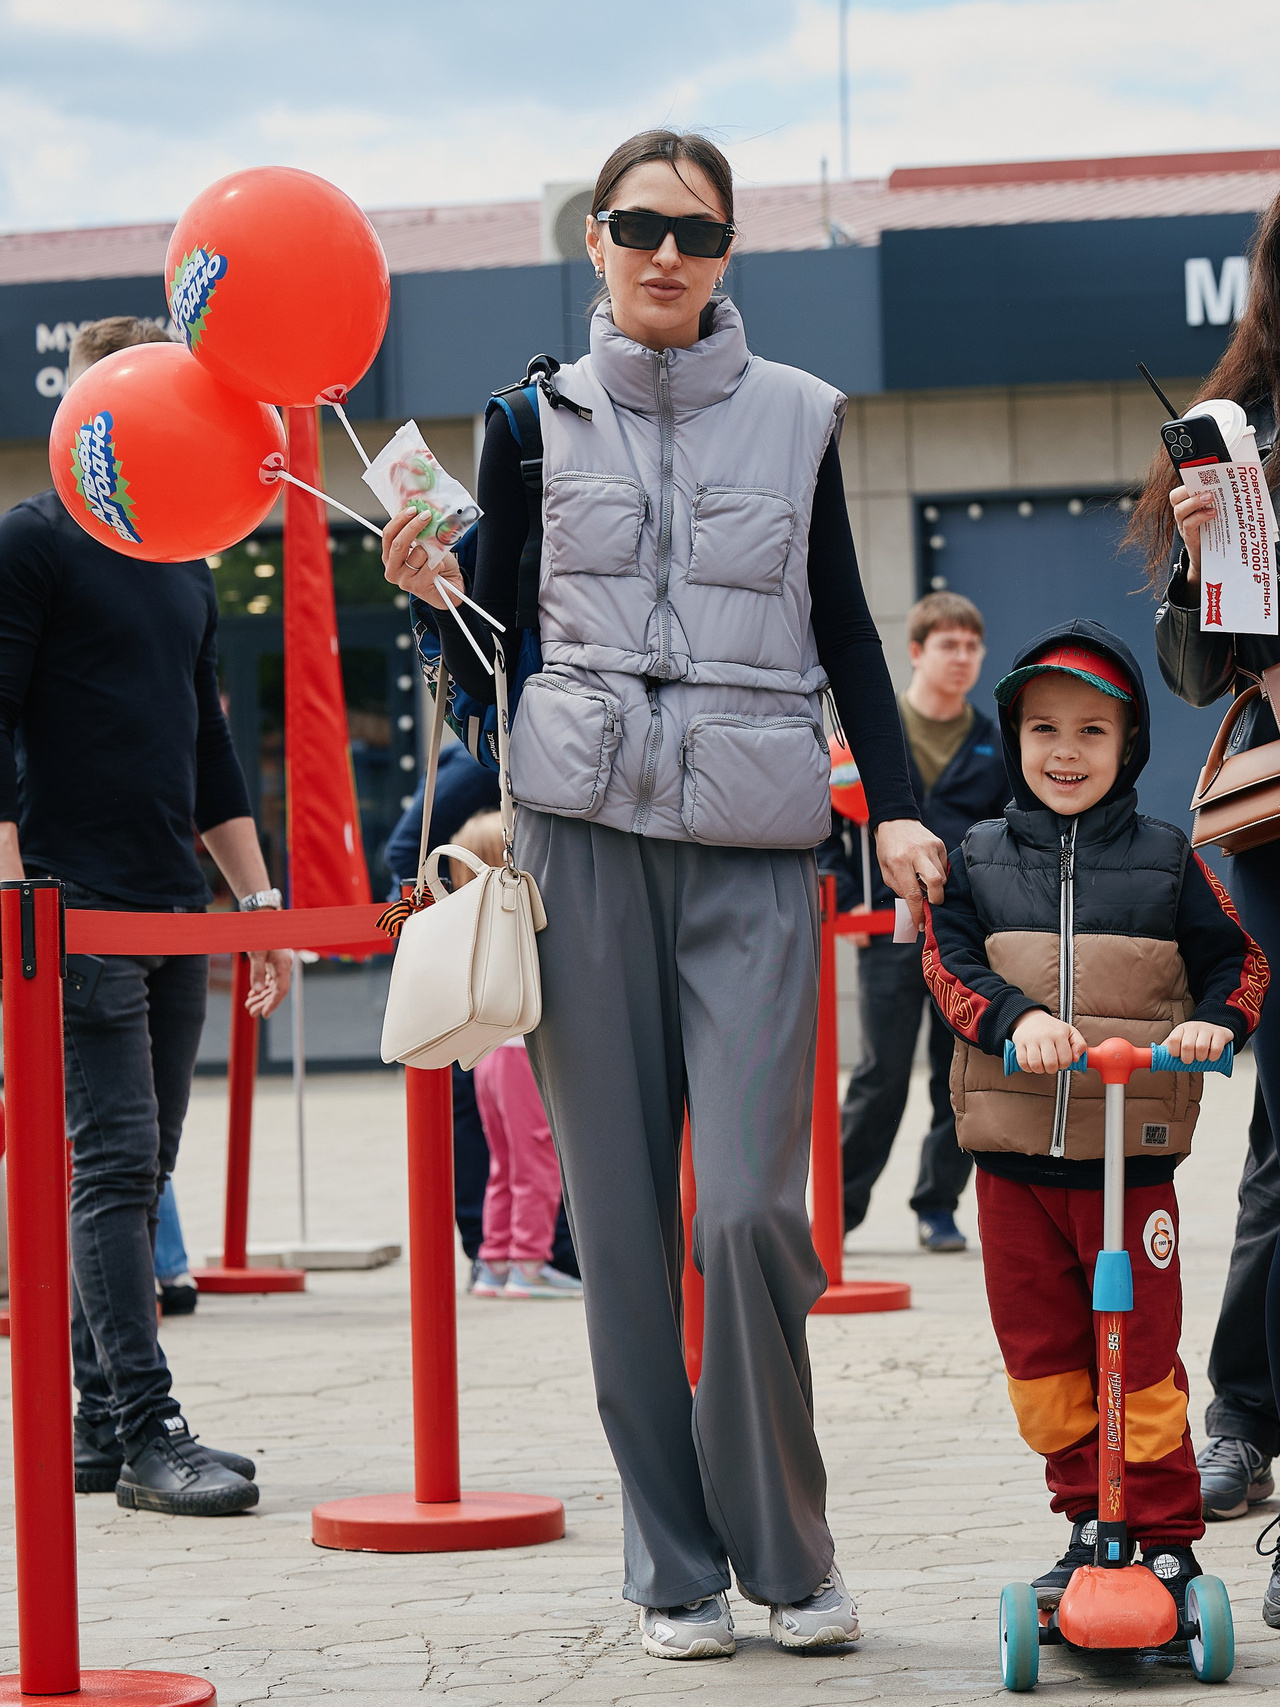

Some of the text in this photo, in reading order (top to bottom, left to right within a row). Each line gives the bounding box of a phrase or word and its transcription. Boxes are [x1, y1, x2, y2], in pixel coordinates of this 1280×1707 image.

[79, 428, 113, 527] АЛЬФА
[92, 415, 141, 545] ВЫГОДНО
[1236, 466, 1254, 522] Получите
[1225, 467, 1249, 567] за каждый совет
[1247, 523, 1257, 538] до
[1248, 466, 1272, 620] Советы приносят деньги.
[1250, 540, 1261, 571] 7000
[1107, 1331, 1121, 1351] 95
